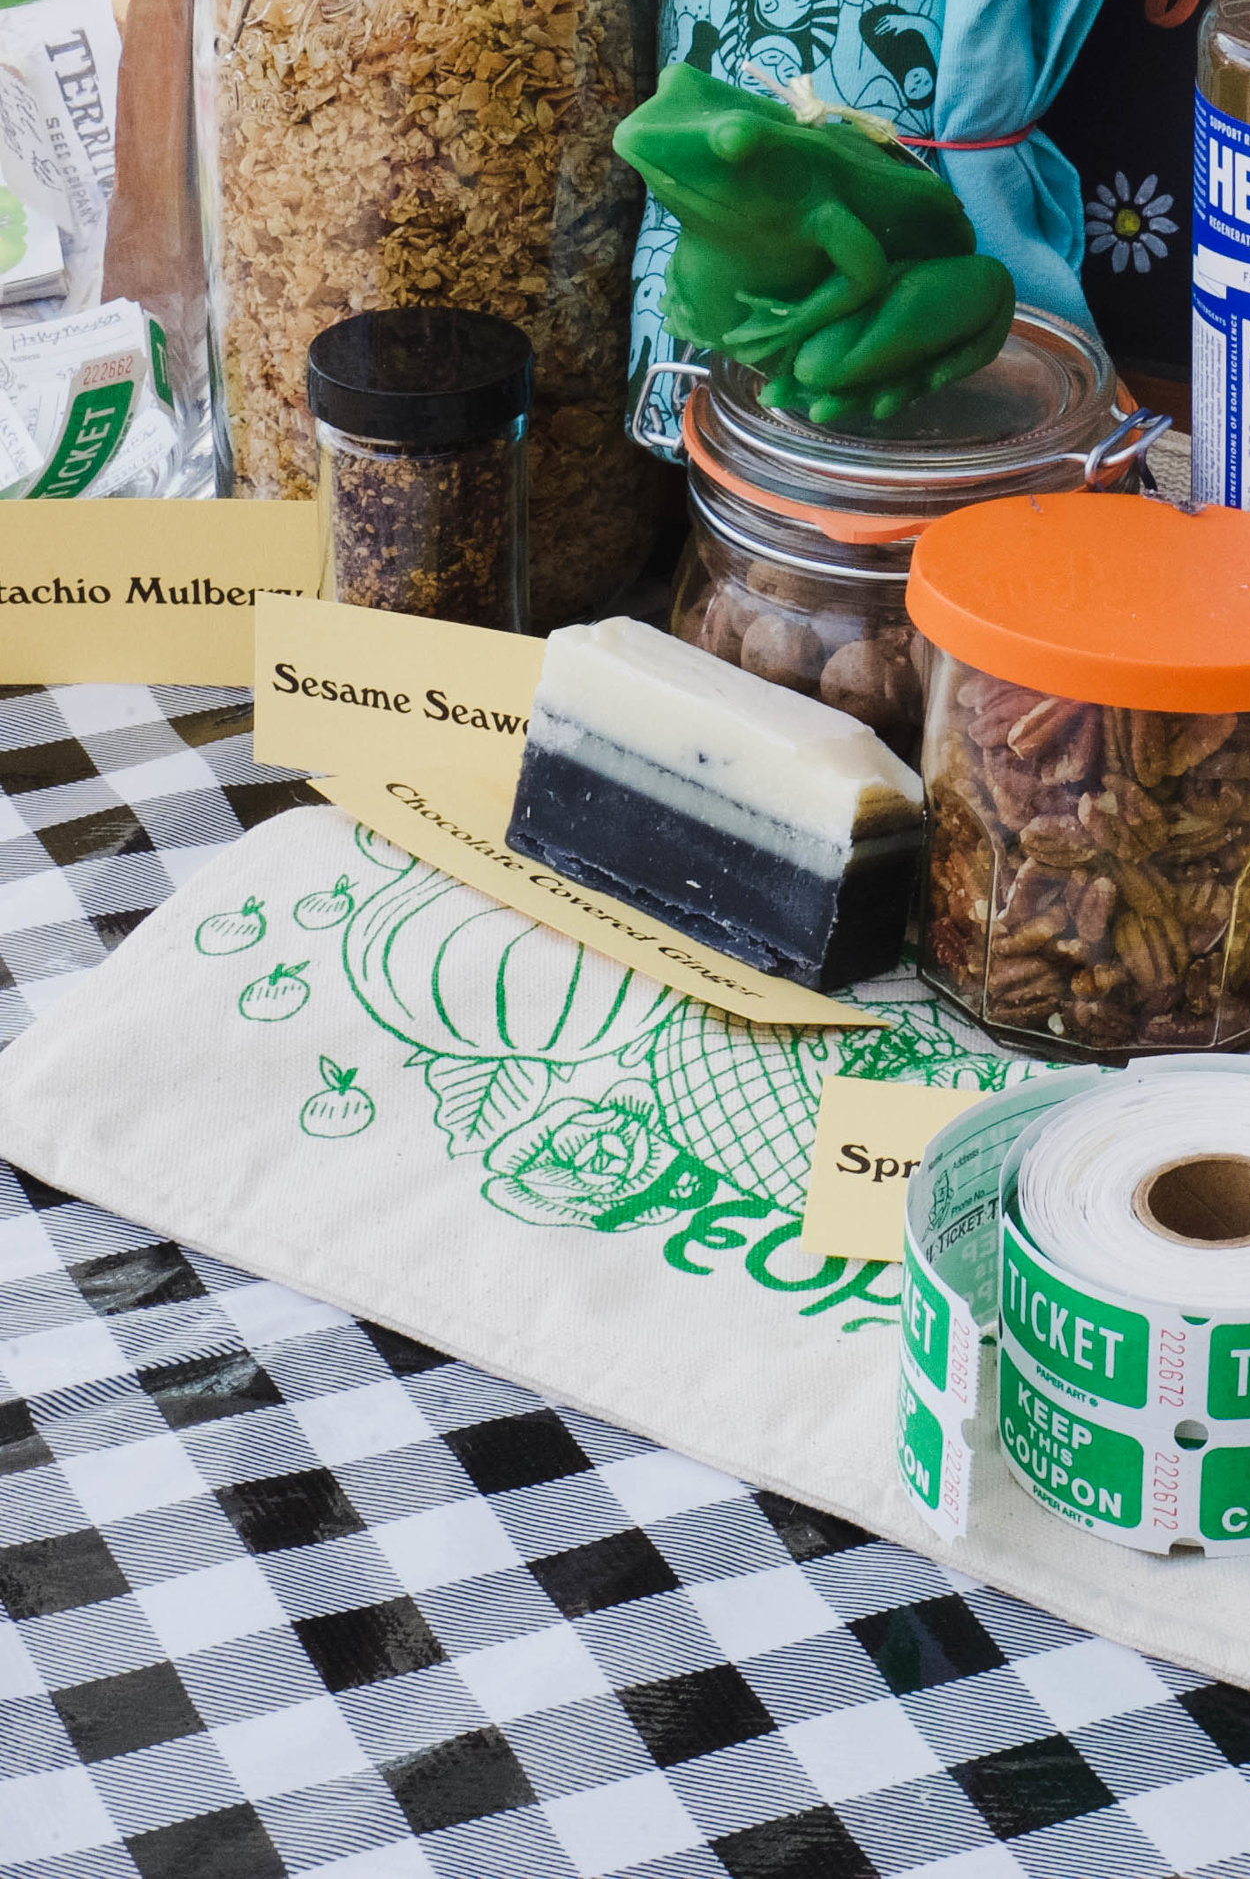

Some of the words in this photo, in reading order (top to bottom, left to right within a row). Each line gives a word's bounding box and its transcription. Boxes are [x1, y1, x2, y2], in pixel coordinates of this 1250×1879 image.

[1209, 115, 1241, 143] SUPPORT
[1230, 313, 1238, 378] EXCELLENCE
[1230, 382, 1238, 413] SOAP
[1229, 434, 1238, 507] GENERATIONS
[125, 577, 304, 607] Mulber
[272, 662, 413, 716] Sesame
[384, 781, 525, 873] Chocolate
[528, 873, 659, 944] Covered
[658, 944, 766, 1000] Ginger
[1007, 1258, 1124, 1380] TICKET
[950, 1317, 971, 1405] 222667
[1036, 1365, 1064, 1392] PAPER
[1065, 1384, 1087, 1401] ART
[1159, 1328, 1187, 1409] 222672
[1017, 1380, 1093, 1450] KEEP
[1028, 1421, 1074, 1468] THIS
[1003, 1416, 1122, 1520] COUPON
[1152, 1451, 1180, 1531] 222672
[1033, 1484, 1061, 1513] PAPER
[1061, 1505, 1082, 1522] ART
